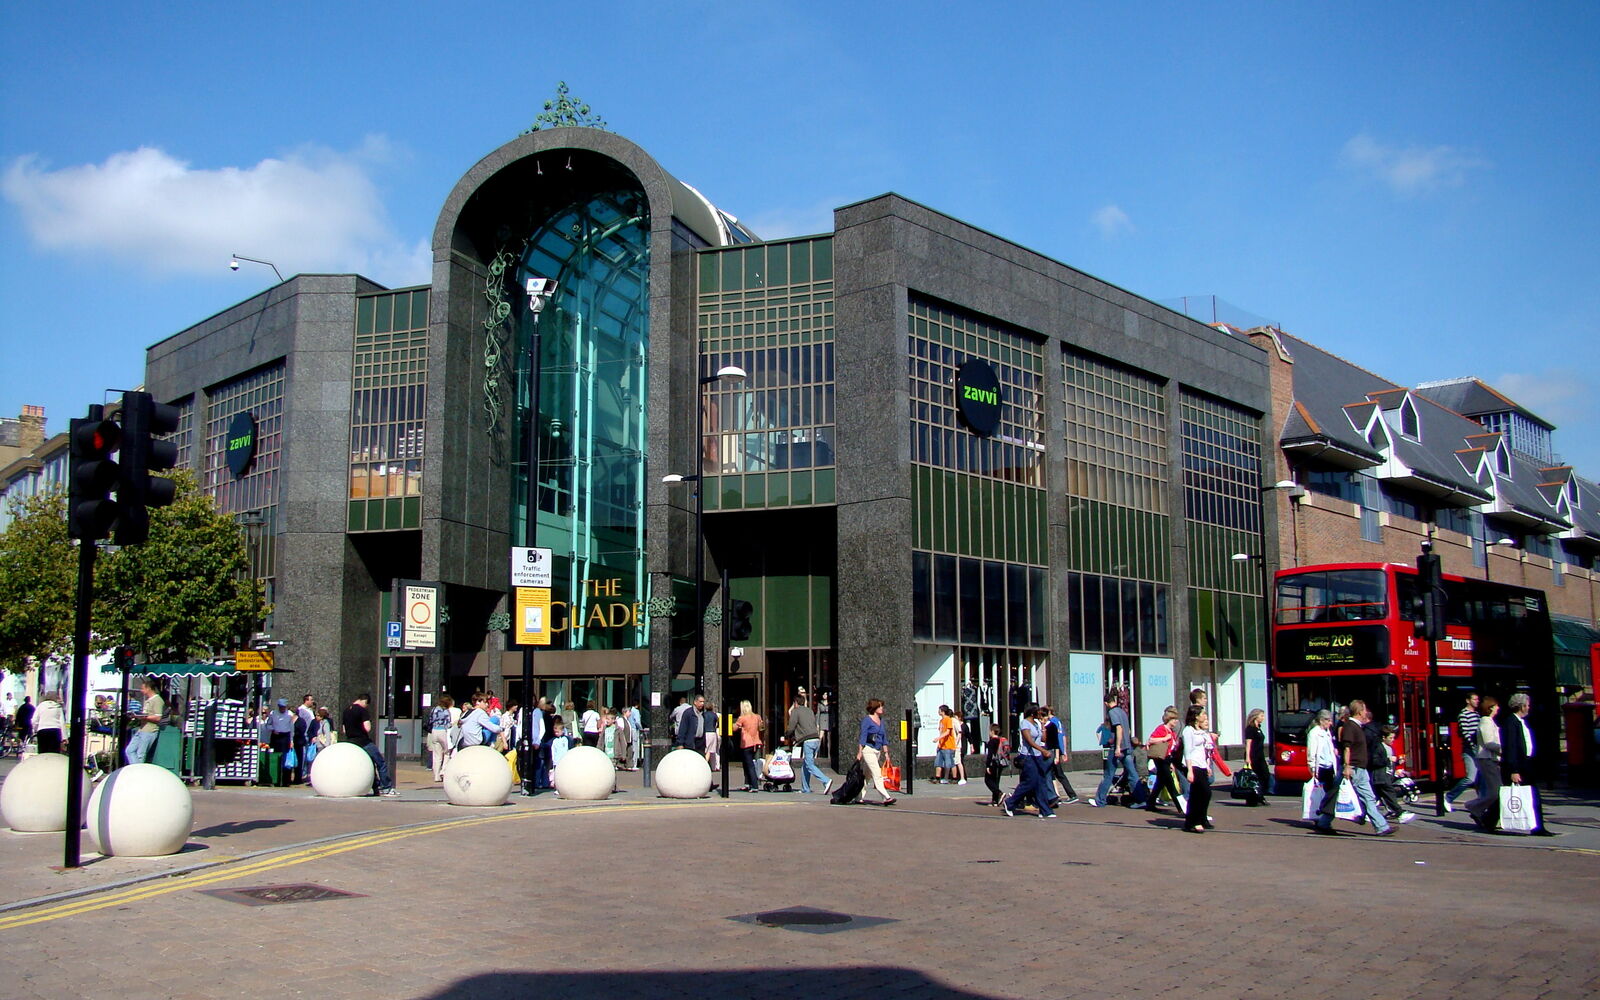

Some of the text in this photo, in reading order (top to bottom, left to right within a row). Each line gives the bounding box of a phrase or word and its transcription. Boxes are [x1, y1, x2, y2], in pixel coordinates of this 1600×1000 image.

[964, 385, 997, 406] zavvi
[229, 429, 251, 451] zavvi
[580, 578, 622, 598] THE
[550, 601, 645, 632] GLADE
[390, 623, 400, 637] P
[1331, 634, 1354, 647] 208
[1073, 671, 1096, 685] oasis
[1148, 674, 1168, 687] oasis
